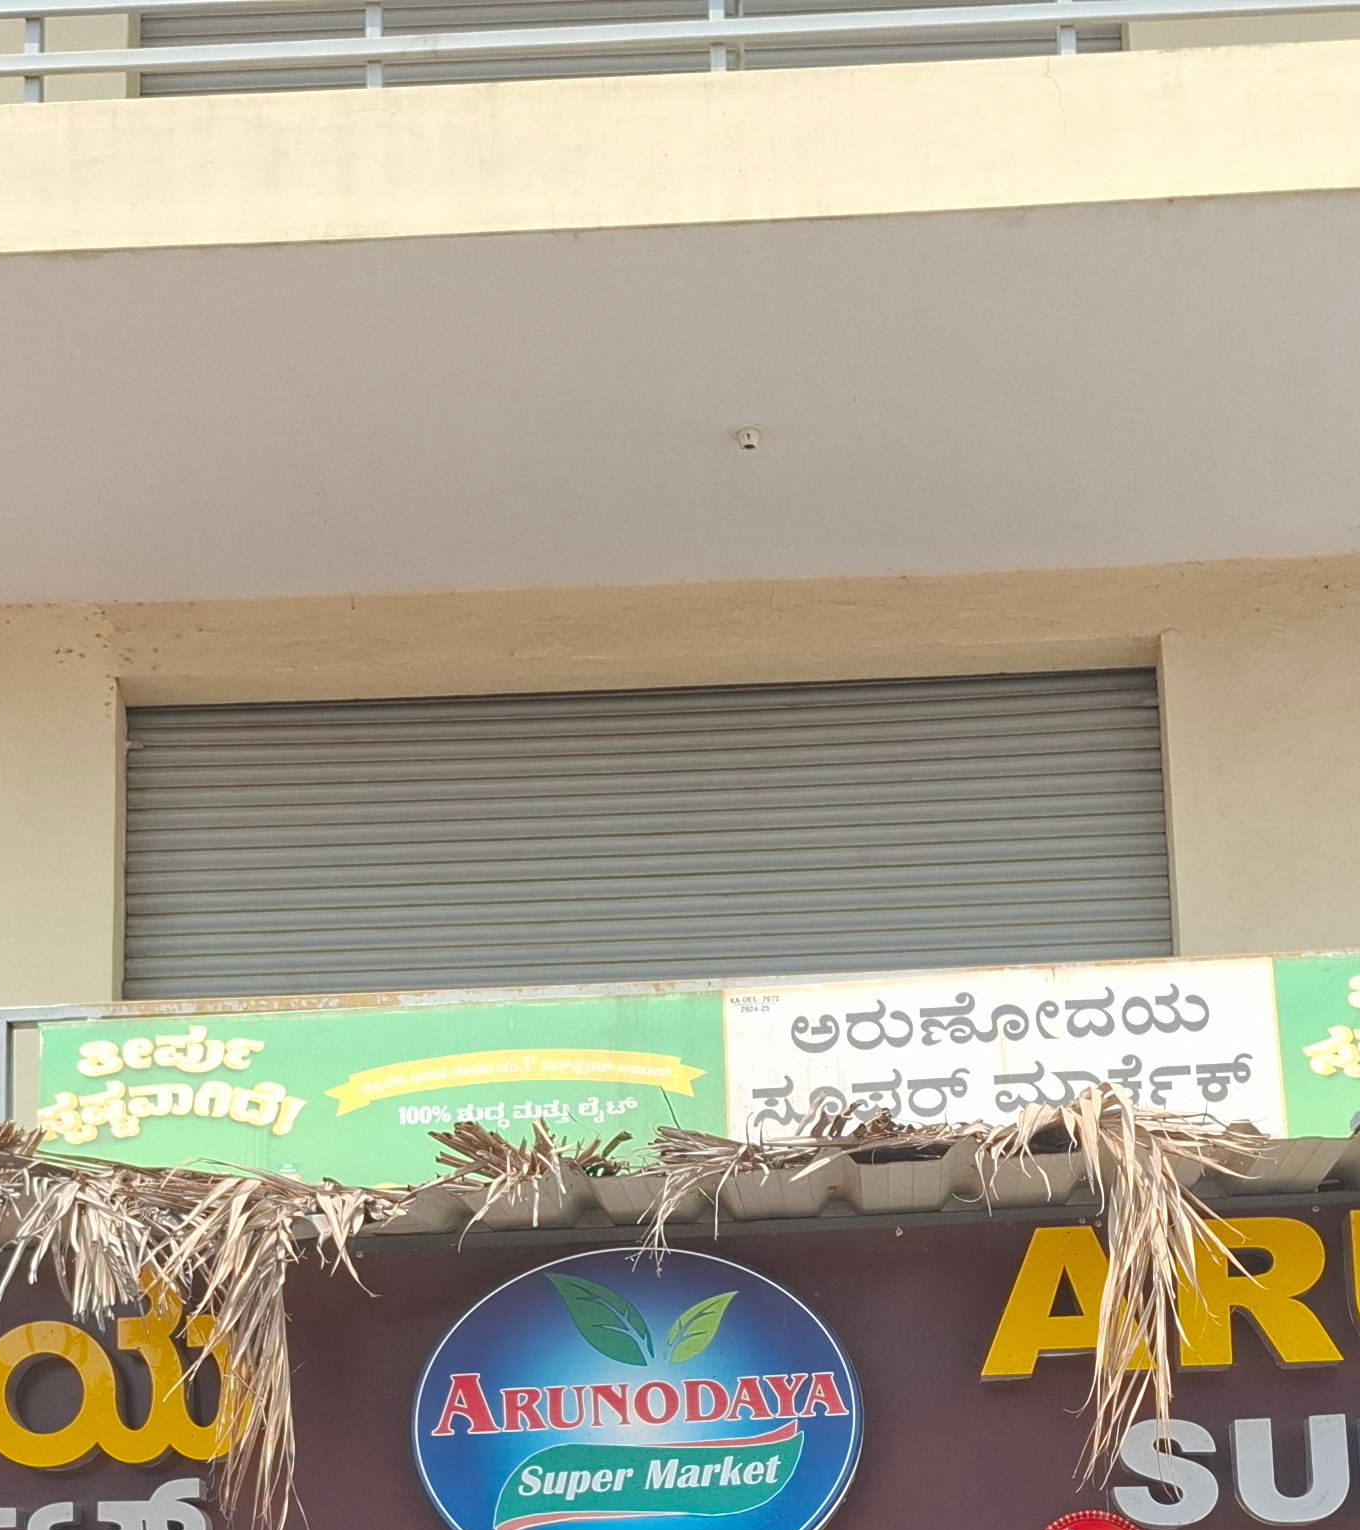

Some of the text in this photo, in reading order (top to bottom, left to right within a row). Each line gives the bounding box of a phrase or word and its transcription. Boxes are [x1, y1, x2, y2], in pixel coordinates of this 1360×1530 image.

[790, 983, 1210, 1054] ಅರುಣೋದಯ
[397, 1105, 451, 1126] 100%
[512, 1099, 570, 1124] ಮತ್ತು
[577, 1095, 638, 1123] ಲೈಟ್
[431, 1371, 849, 1437] ARUNODAYA
[517, 1452, 782, 1502] Super Market
